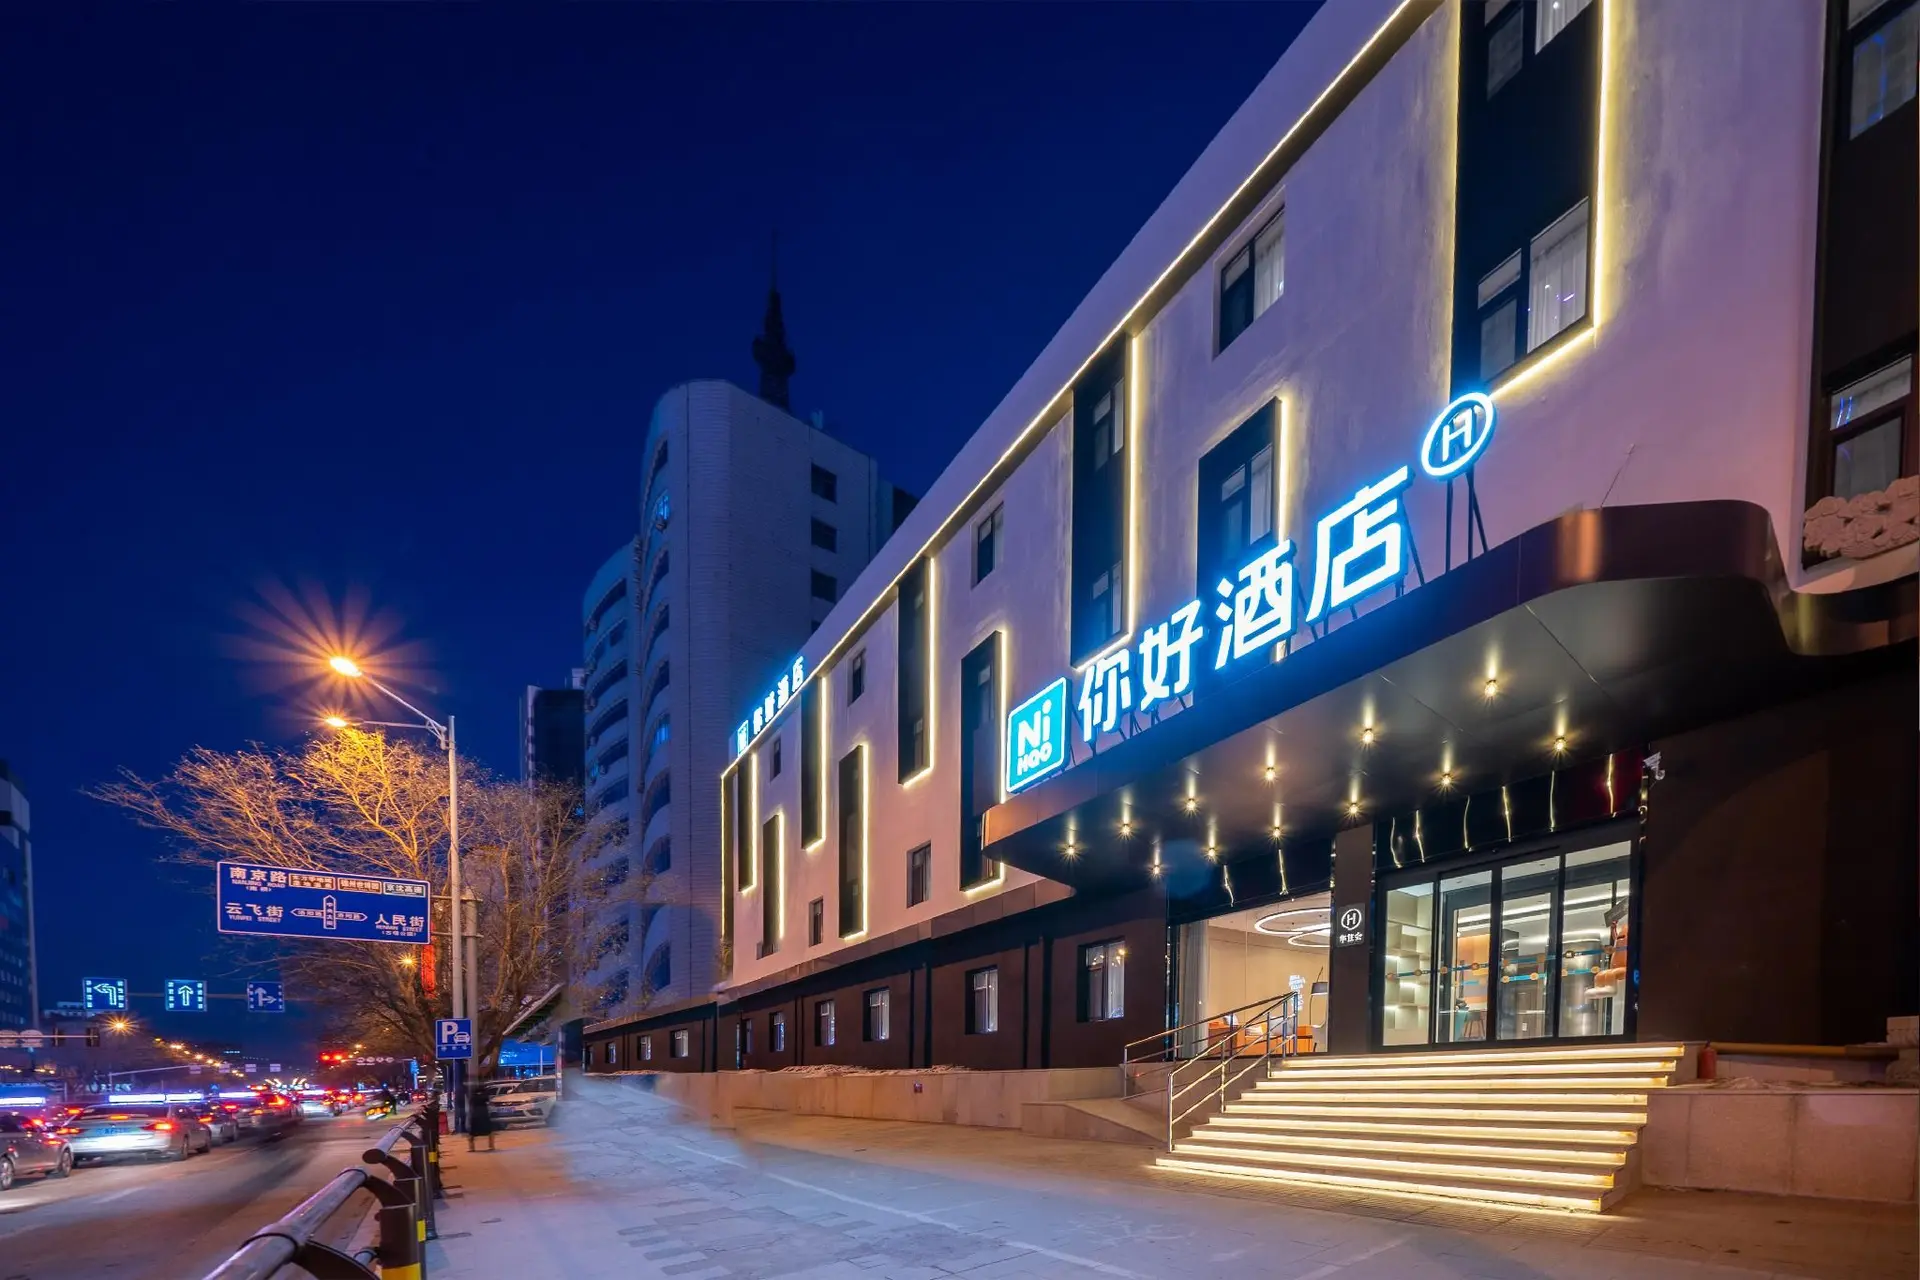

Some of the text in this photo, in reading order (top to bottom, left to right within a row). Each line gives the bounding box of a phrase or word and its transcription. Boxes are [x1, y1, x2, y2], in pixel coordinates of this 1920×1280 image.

[1078, 466, 1414, 742] 你好酒店
[1017, 699, 1052, 757] Ni
[229, 867, 287, 883] 南京路
[225, 902, 284, 918] 云飞街
[375, 913, 425, 927] 人民街
[441, 1021, 458, 1043] P
